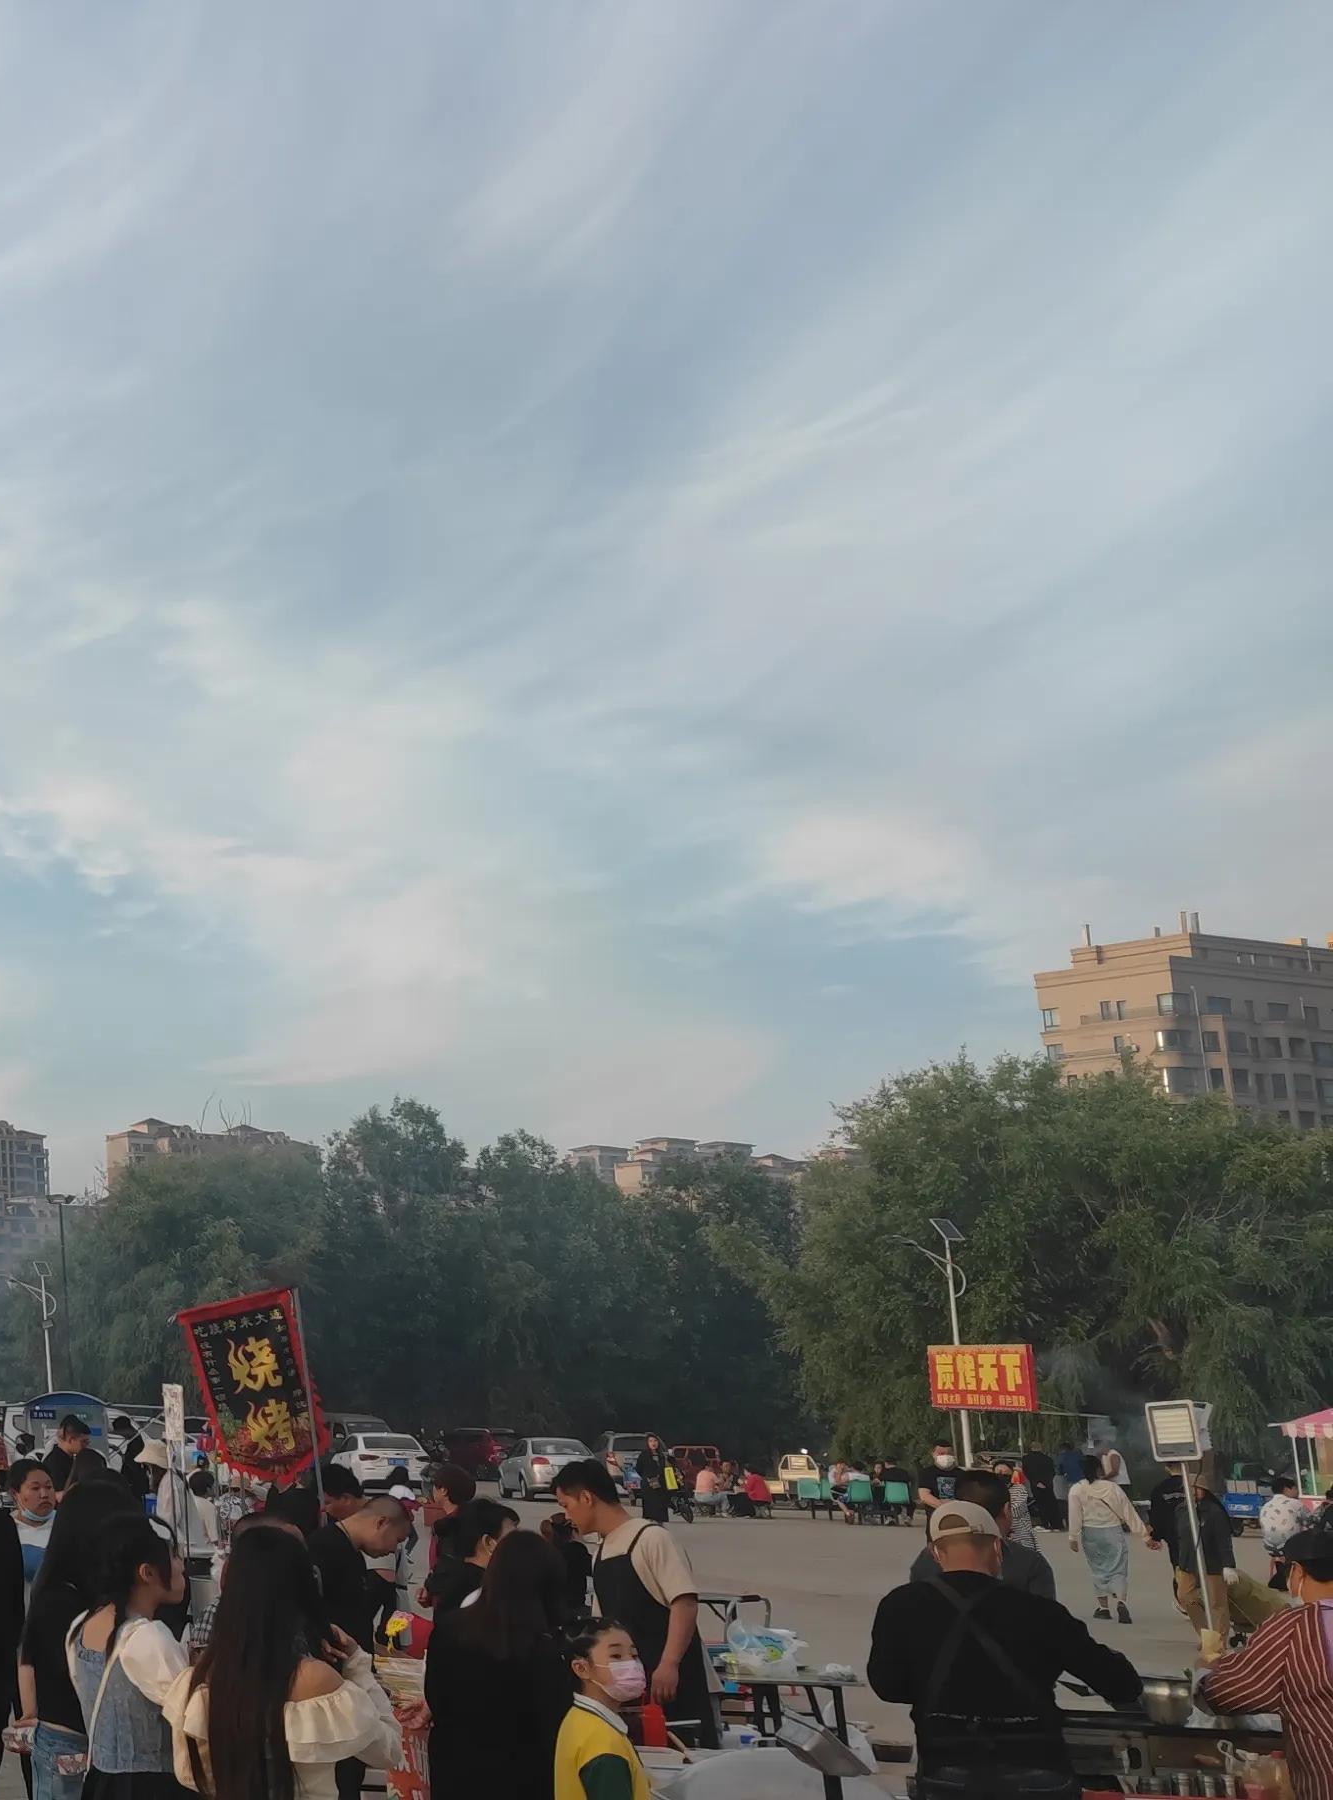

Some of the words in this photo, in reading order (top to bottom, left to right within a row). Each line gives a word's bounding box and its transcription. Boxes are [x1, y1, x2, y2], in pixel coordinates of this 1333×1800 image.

[227, 1335, 296, 1456] 烧烤
[935, 1353, 1023, 1392] 炭烤天下
